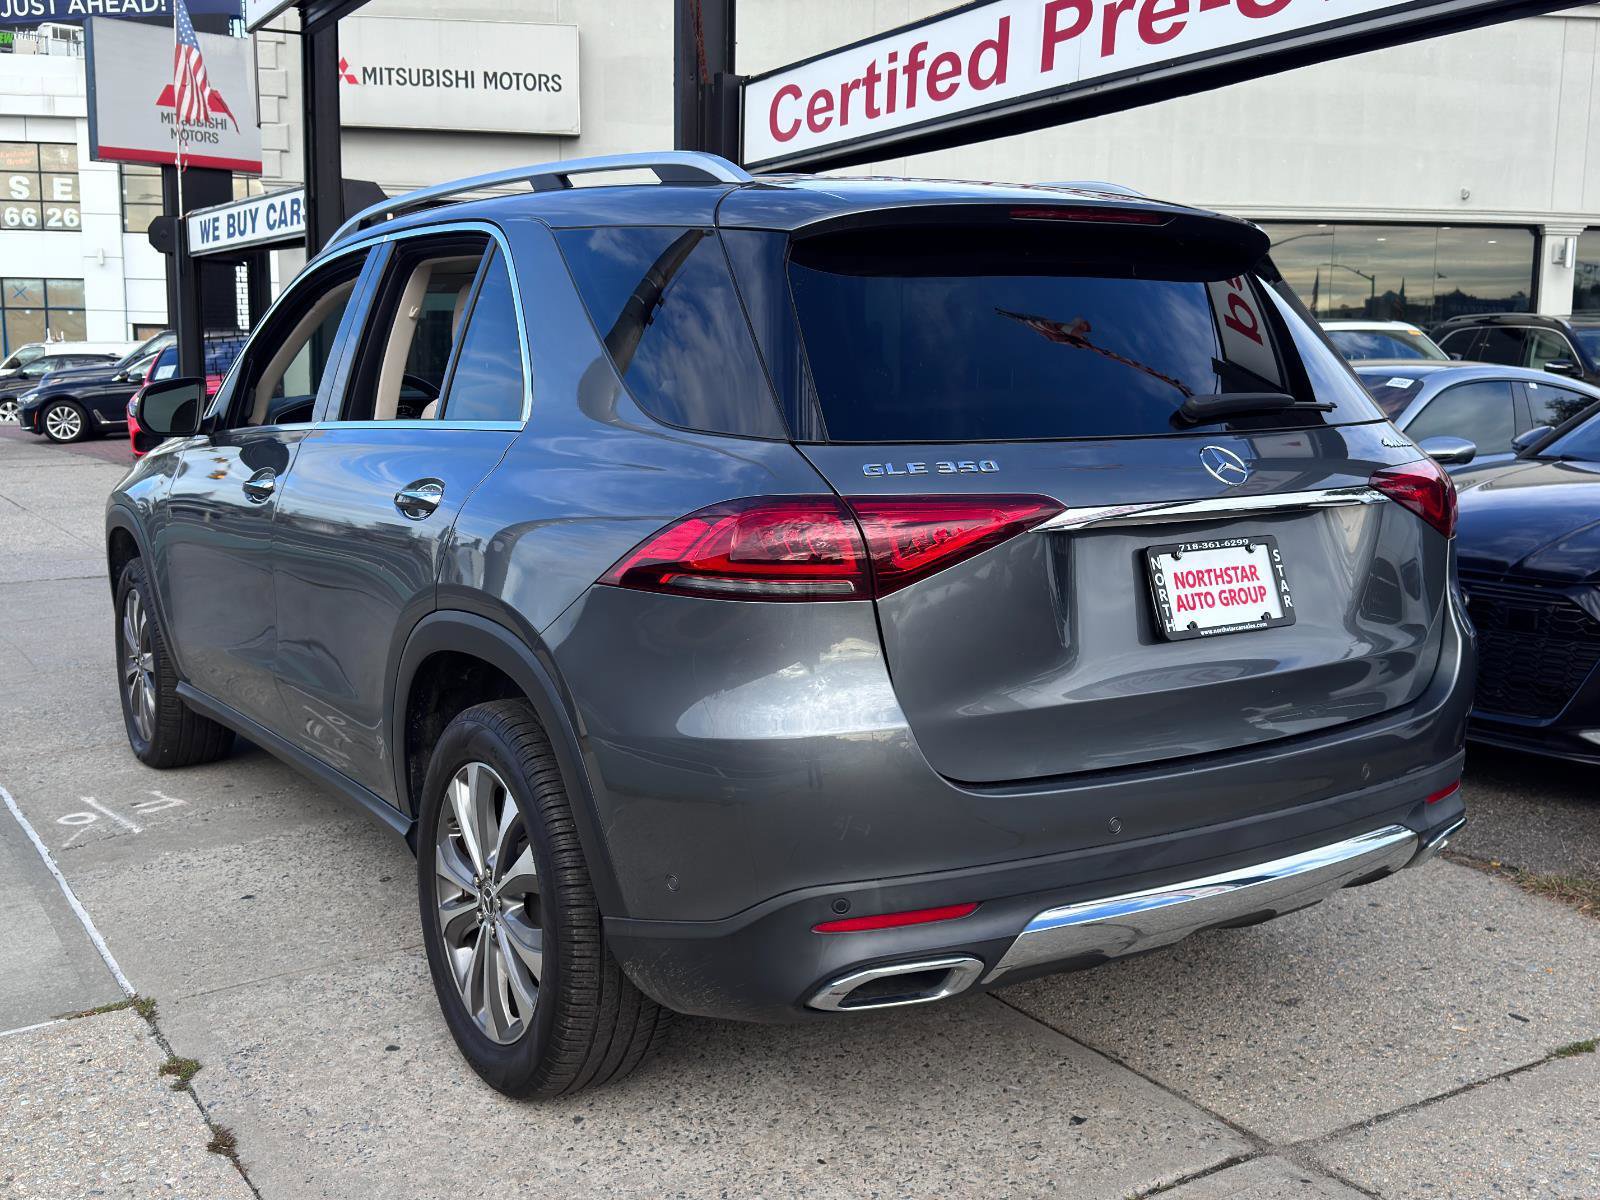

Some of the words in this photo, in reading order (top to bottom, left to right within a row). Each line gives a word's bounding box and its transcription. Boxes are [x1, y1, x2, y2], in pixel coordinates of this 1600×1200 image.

[1, 0, 56, 17] JUST
[68, 0, 167, 14] AHEAD!
[362, 66, 475, 89] MITSUBISHI
[483, 71, 562, 93] MOTORS
[769, 15, 1011, 143] Certifed
[160, 111, 227, 130] MIUBISHI
[200, 217, 220, 244] WE
[227, 207, 259, 239] BUY
[266, 197, 306, 231] CAR
[862, 462, 929, 476] GLE
[935, 459, 1000, 475] 350
[1178, 538, 1249, 551] 718-361-6299
[1173, 564, 1260, 590] NORTHSTAR
[1272, 549, 1293, 608] STAR
[1150, 556, 1176, 633] NORTH
[1176, 590, 1216, 613] AUTO
[1218, 585, 1267, 607] GROUP
